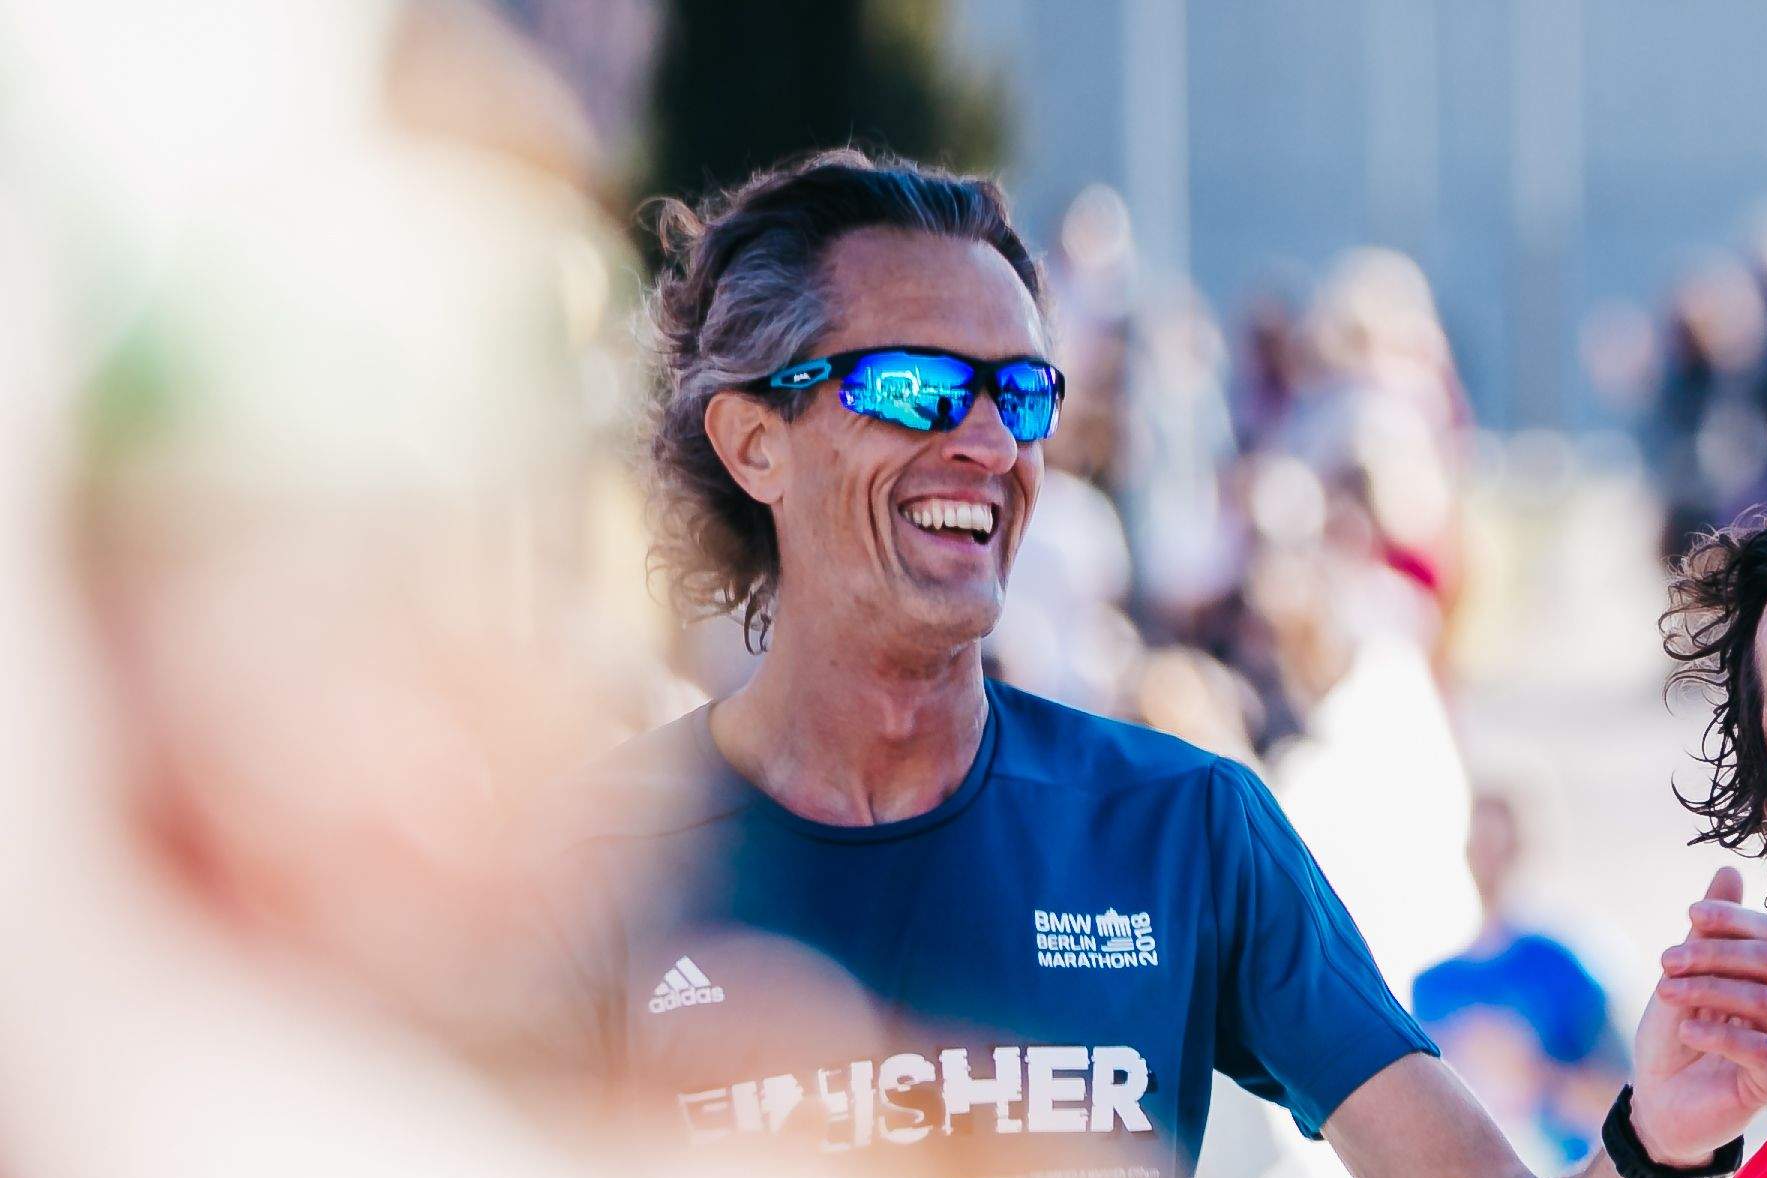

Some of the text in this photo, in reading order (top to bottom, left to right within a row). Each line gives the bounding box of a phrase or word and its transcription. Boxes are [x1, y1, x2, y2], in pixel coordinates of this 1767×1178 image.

[1034, 909, 1092, 935] BMW
[1036, 933, 1097, 952] BERLIN
[1130, 911, 1159, 967] 2018
[1037, 950, 1138, 969] MARATHON
[648, 986, 724, 1014] adidas
